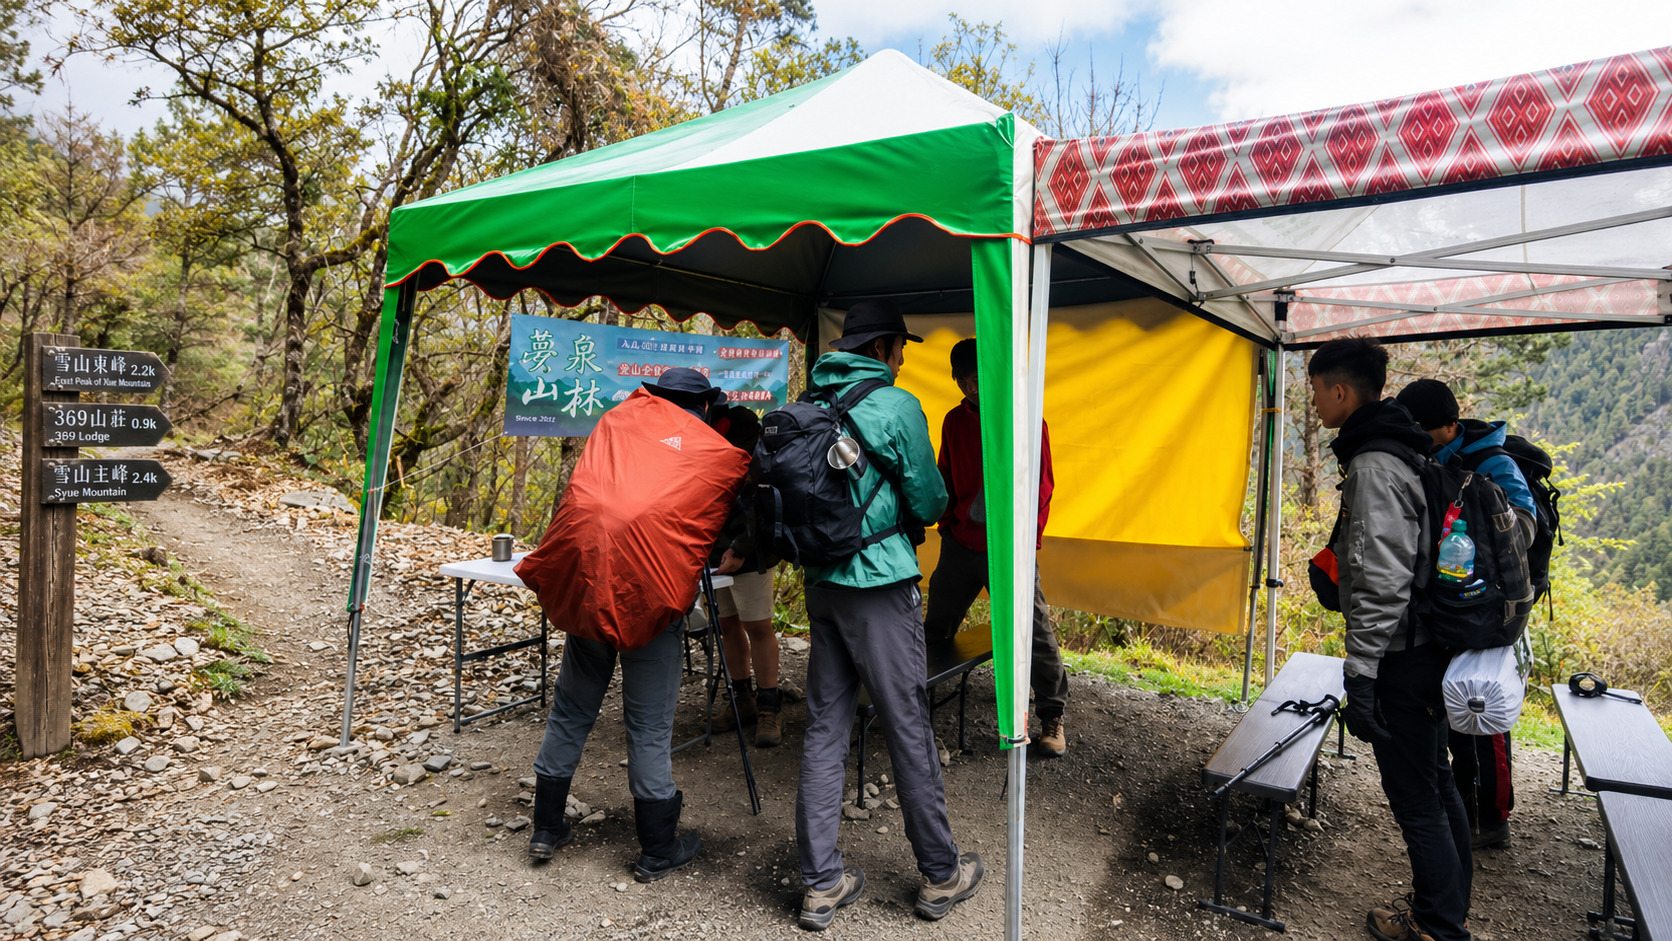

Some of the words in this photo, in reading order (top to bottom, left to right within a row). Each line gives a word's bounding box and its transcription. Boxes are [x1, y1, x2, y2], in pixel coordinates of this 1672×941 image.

[54, 352, 127, 375] 雪山東峰
[130, 364, 156, 377] 2.2k
[93, 377, 102, 386] of
[521, 376, 604, 418] 山林
[54, 408, 127, 428] 369山莊
[131, 418, 157, 430] 0.9k
[54, 431, 76, 441] 369
[78, 431, 110, 443] Lodge
[54, 463, 129, 484] 雪山主峰
[131, 472, 158, 484] 2.4k
[54, 487, 80, 499] Syue
[82, 486, 127, 497] Mountain
